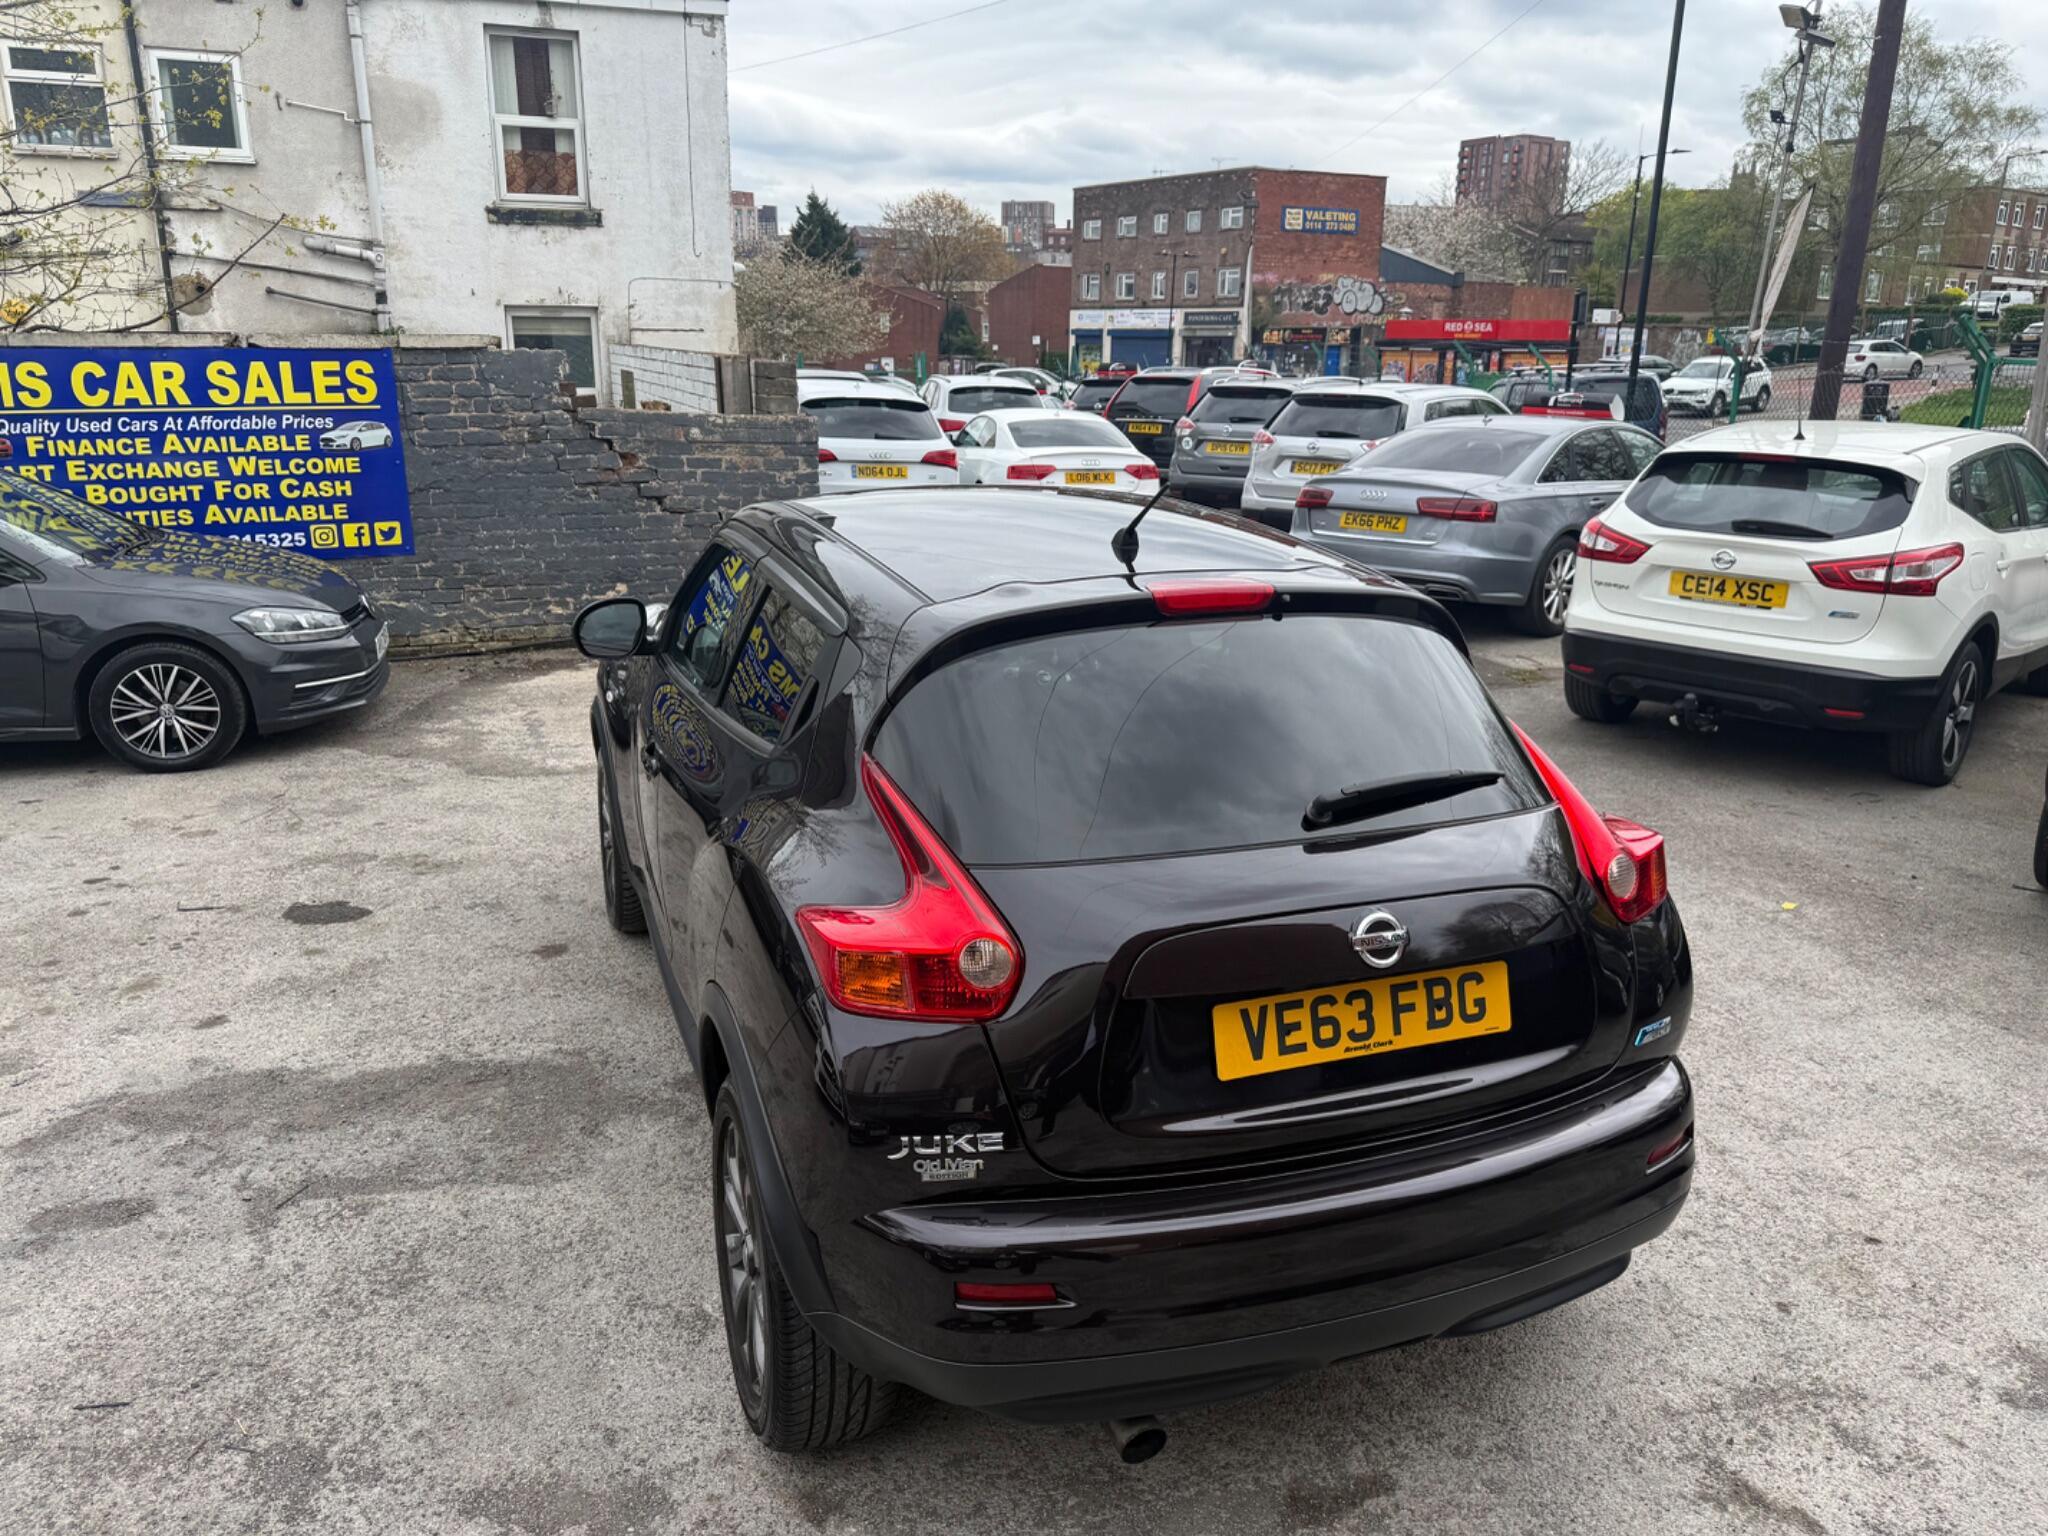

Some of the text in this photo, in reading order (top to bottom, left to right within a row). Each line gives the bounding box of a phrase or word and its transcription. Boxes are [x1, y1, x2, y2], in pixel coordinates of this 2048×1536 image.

[1306, 210, 1356, 221] VALETING
[1444, 322, 1493, 332] RED SEA
[71, 361, 191, 408] CAR
[206, 360, 378, 406] SALES
[0, 414, 334, 437] Quality Used Cars At Affordable Prices
[26, 432, 312, 458] FINANCE AVAILABLE
[66, 459, 220, 482] EXCHANGE
[228, 456, 362, 477] WELCOME
[85, 478, 353, 505] BOUGHT FOR CASH
[204, 503, 349, 525] AVAILABLE
[1343, 512, 1401, 530] EK66 PHZ
[1682, 575, 1775, 602] CE14 XSC
[1360, 934, 1405, 947] NISSAN
[1240, 971, 1487, 1061] VE63 FBG
[1344, 1039, 1394, 1053] Arnold Clark
[887, 1132, 1005, 1160] JUKE
